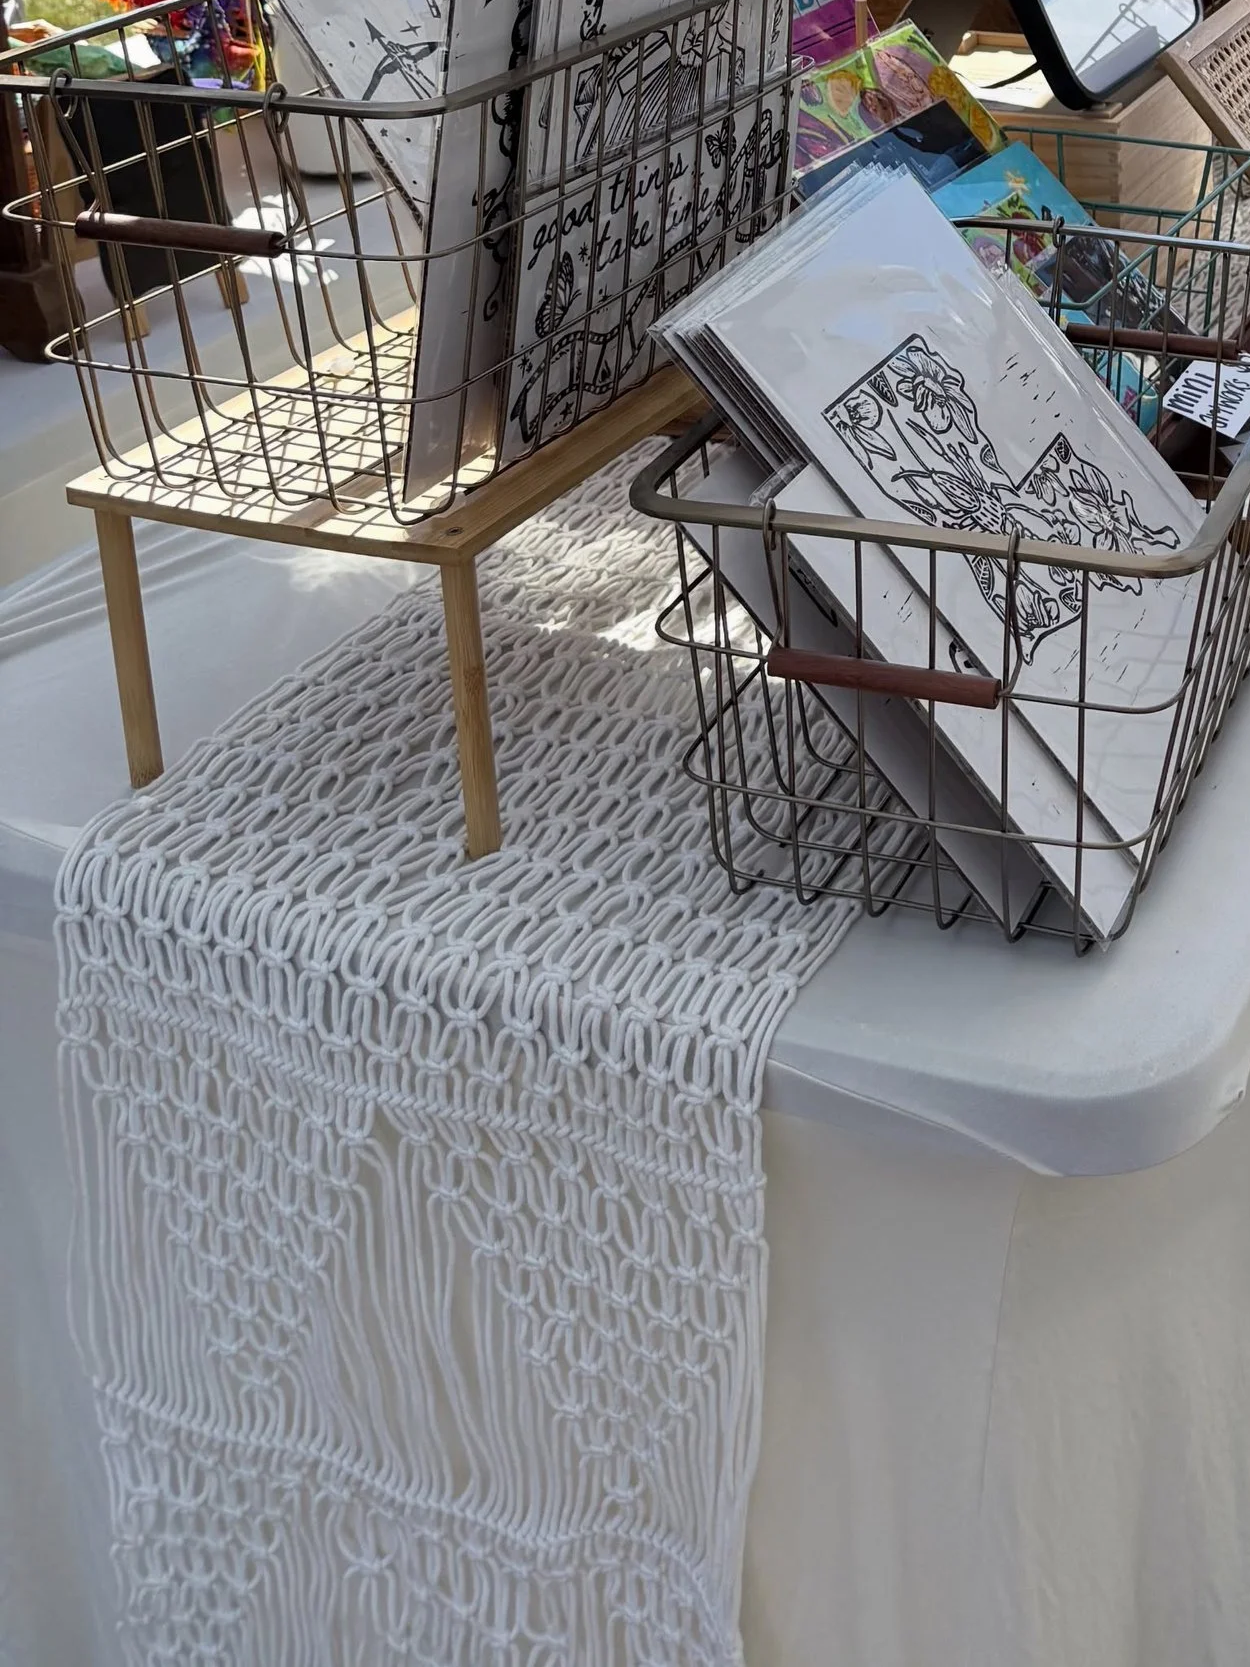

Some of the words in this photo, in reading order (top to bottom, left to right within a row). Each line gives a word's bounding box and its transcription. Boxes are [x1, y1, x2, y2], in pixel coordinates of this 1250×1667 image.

[528, 185, 598, 271] good
[597, 211, 653, 272] take
[1167, 370, 1215, 414] mini
